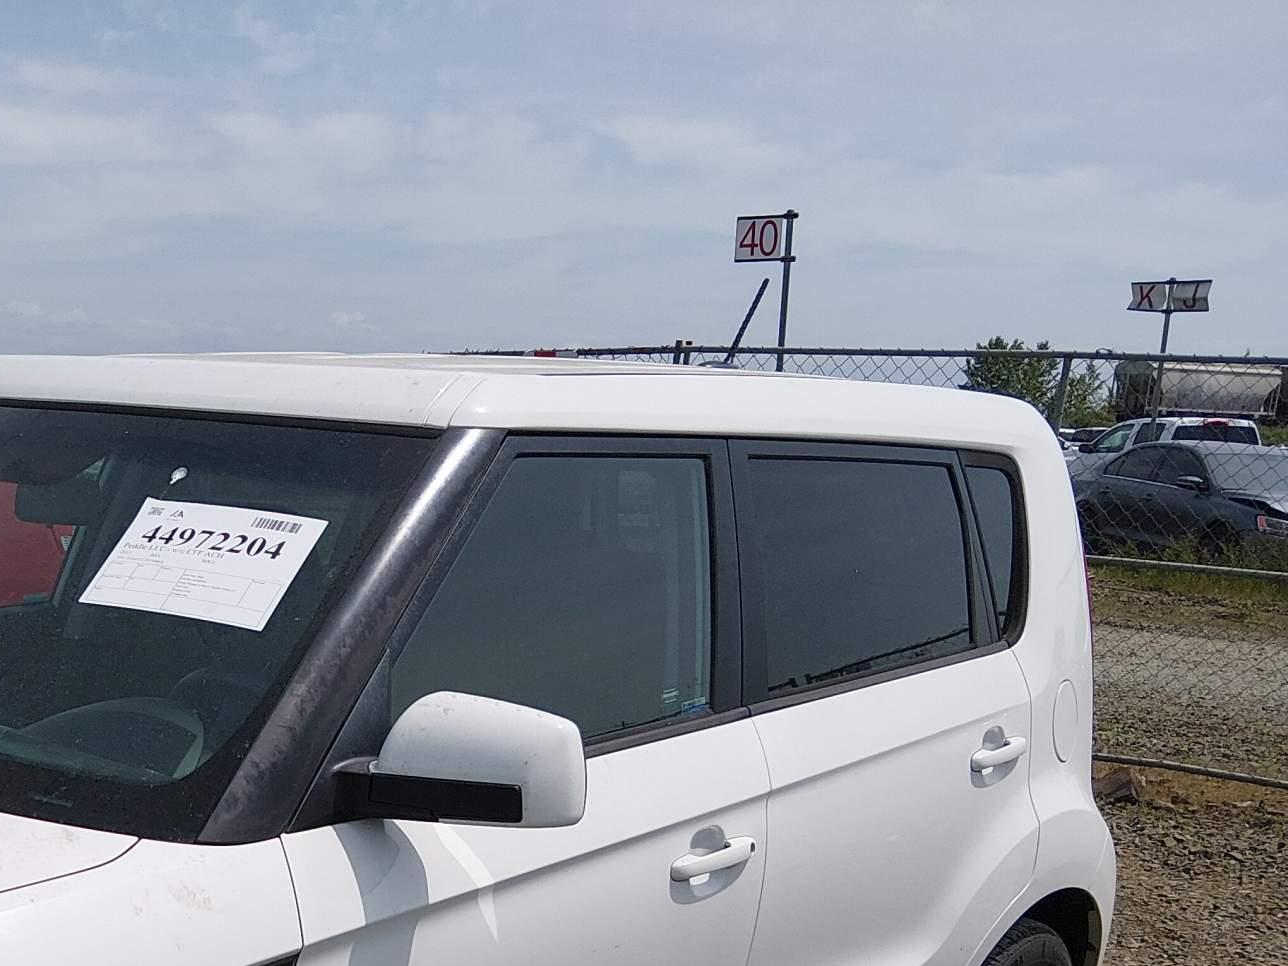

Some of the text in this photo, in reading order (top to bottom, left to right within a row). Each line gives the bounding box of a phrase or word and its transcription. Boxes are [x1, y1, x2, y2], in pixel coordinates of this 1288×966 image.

[739, 220, 779, 257] 40
[1136, 285, 1155, 309] K
[1183, 283, 1200, 309] J
[141, 524, 288, 560] 44972204
